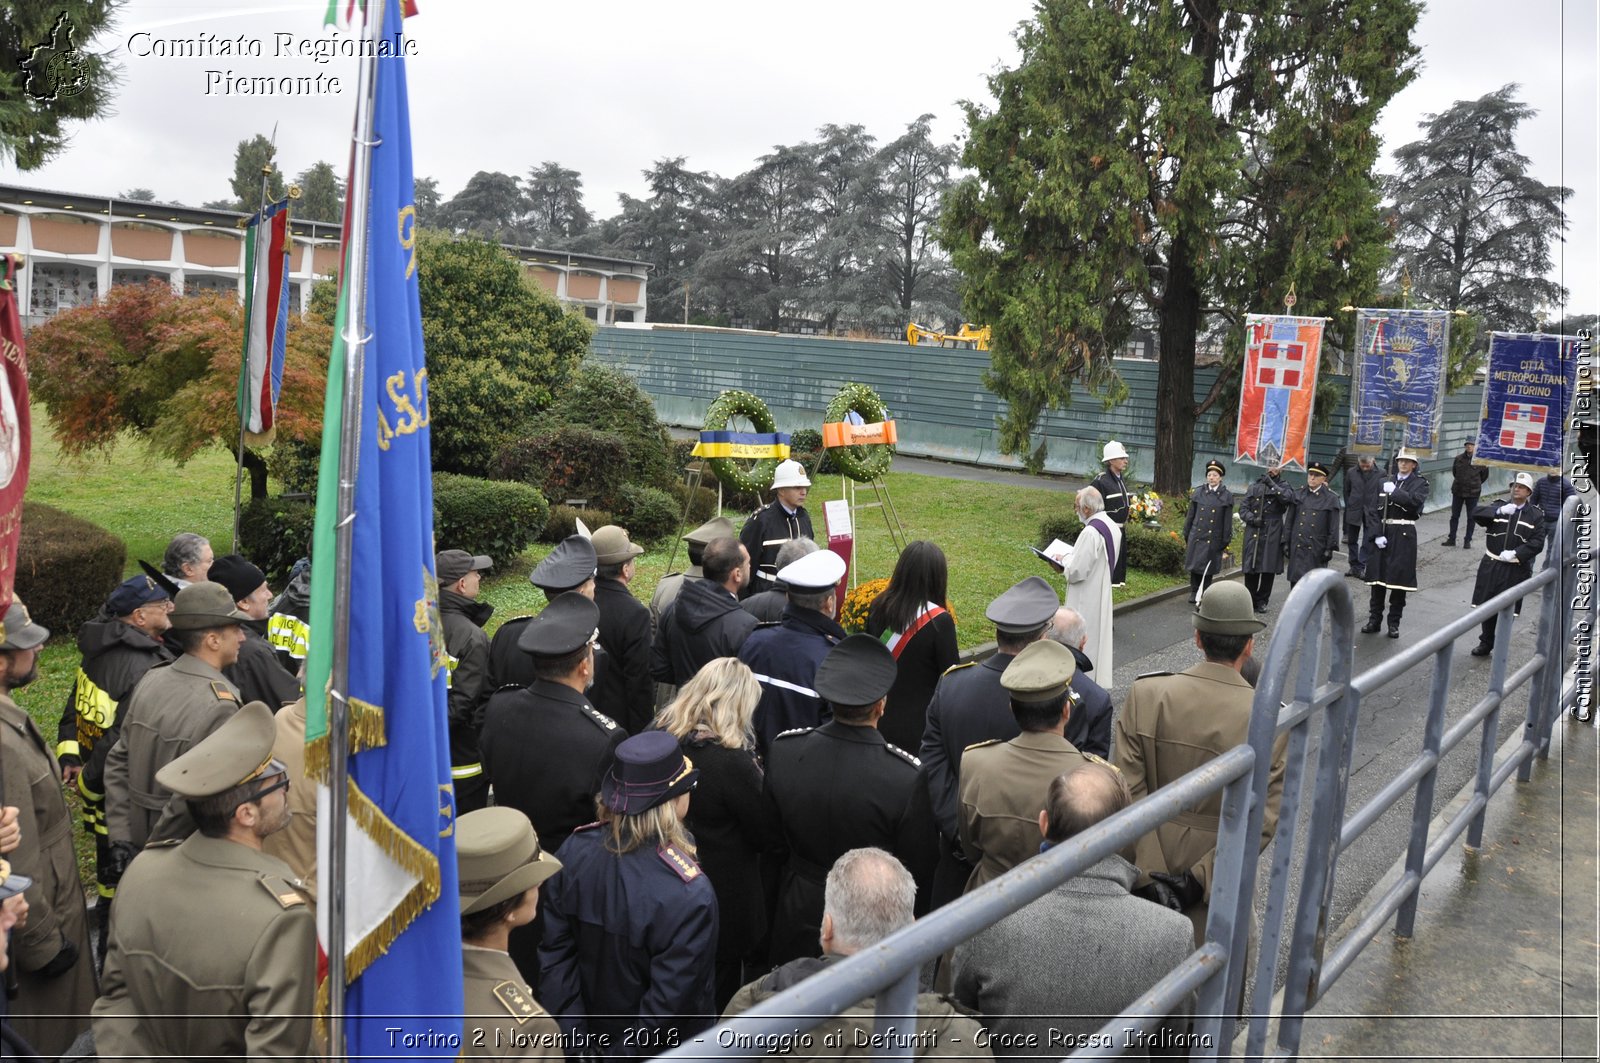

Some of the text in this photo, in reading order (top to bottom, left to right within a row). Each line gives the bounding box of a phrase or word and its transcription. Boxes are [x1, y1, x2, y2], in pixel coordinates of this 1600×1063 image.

[1494, 370, 1568, 385] METROPOLITANA
[1507, 384, 1551, 397] DI TORINO
